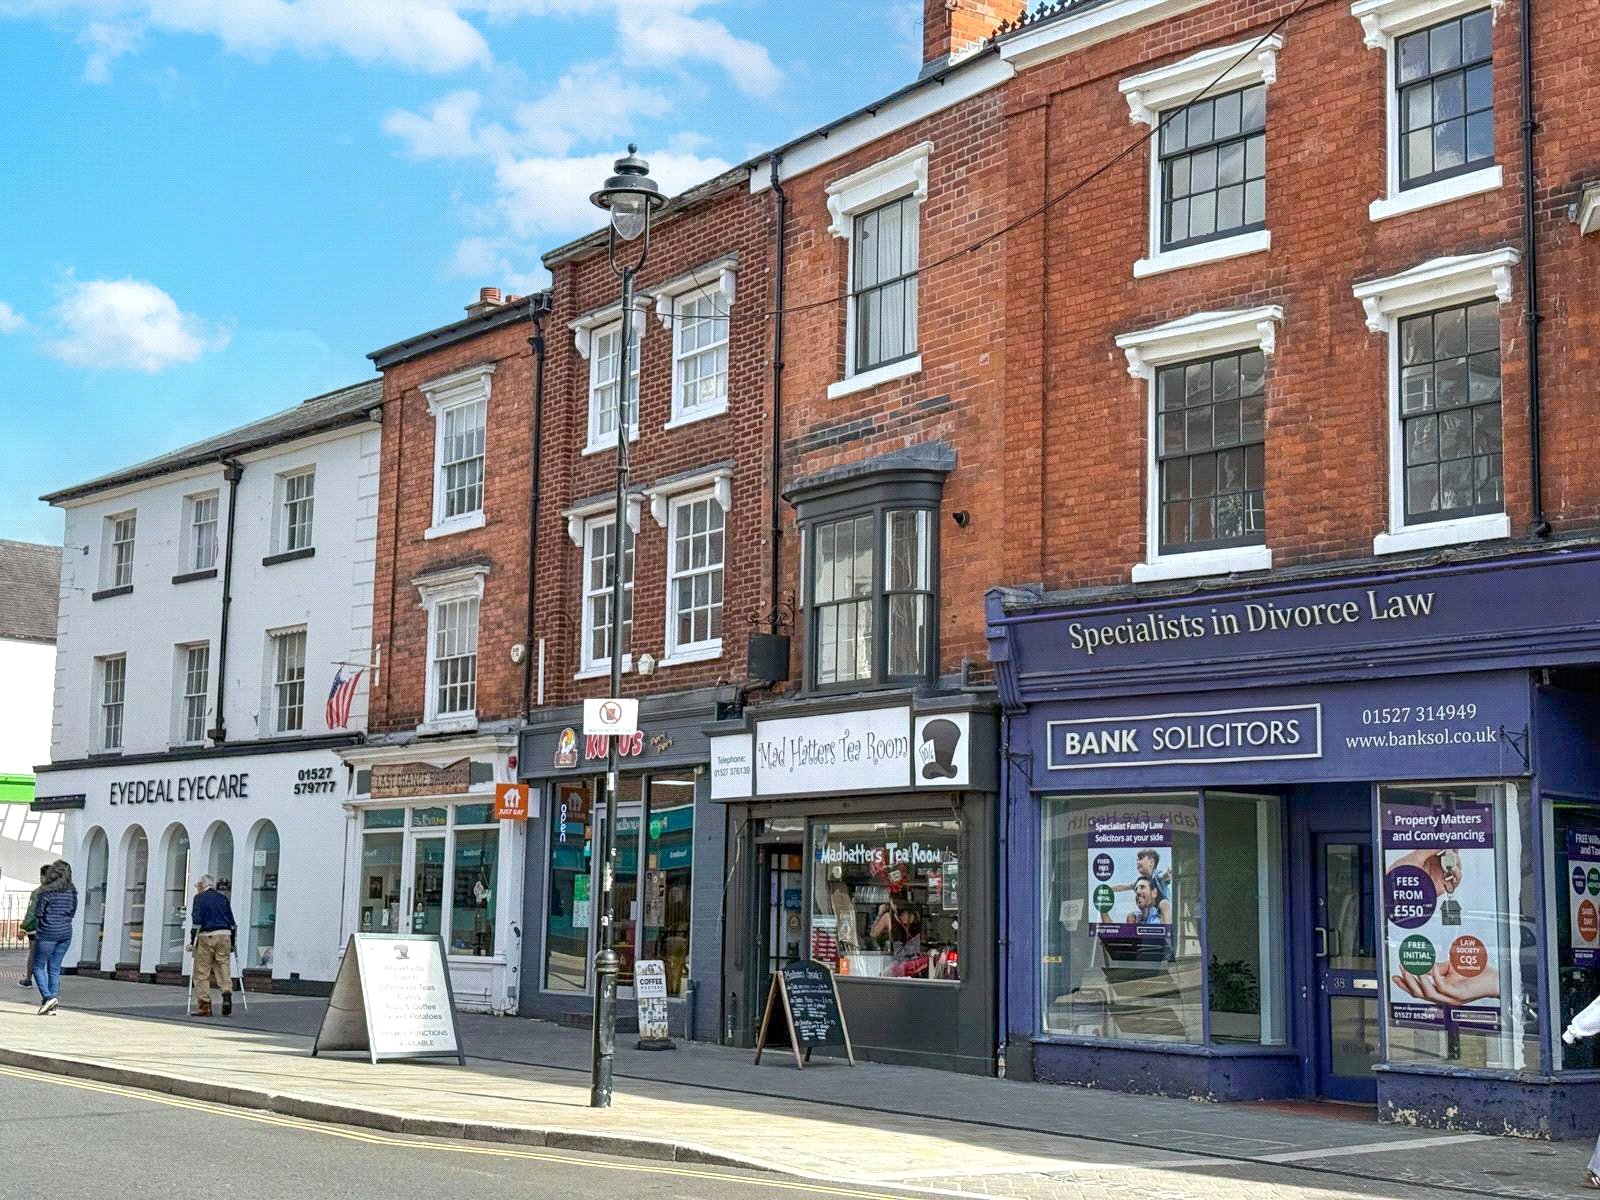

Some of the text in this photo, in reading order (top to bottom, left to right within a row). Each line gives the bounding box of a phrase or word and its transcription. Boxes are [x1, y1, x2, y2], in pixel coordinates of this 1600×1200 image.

[1068, 589, 1436, 655] Specialists in Divorce Law
[1362, 703, 1477, 725] 01527 314949
[1065, 719, 1300, 756] BANK SOLICITORS
[1345, 726, 1497, 749] www.banksol.co.uk
[758, 728, 908, 773] Mad Hatters Tea Room
[297, 767, 334, 782] 01527
[714, 765, 751, 777] 01527 376139
[109, 773, 249, 806] EYEDEAL EYECARE
[293, 781, 336, 796] 579777
[498, 808, 513, 816] JUST
[1095, 821, 1163, 832] Specialist Family Law
[1394, 814, 1482, 828] Property Matters
[1095, 834, 1125, 843] Solicitors
[1133, 836, 1149, 844] your
[1149, 833, 1164, 842] side
[1392, 829, 1485, 843] and Conveyancing
[820, 842, 883, 865] Madhatters
[885, 842, 910, 865] Tea
[1397, 876, 1420, 886] FEES
[1393, 890, 1423, 900] FROM
[1394, 905, 1424, 917] £550
[1407, 941, 1427, 949] FREE
[1459, 939, 1476, 947] LAW
[1403, 951, 1432, 960] INITIAL
[1459, 955, 1478, 966] CQS
[640, 978, 663, 986] COFFEE
[1334, 977, 1345, 989] 38
[1394, 1011, 1412, 1019] 01527
